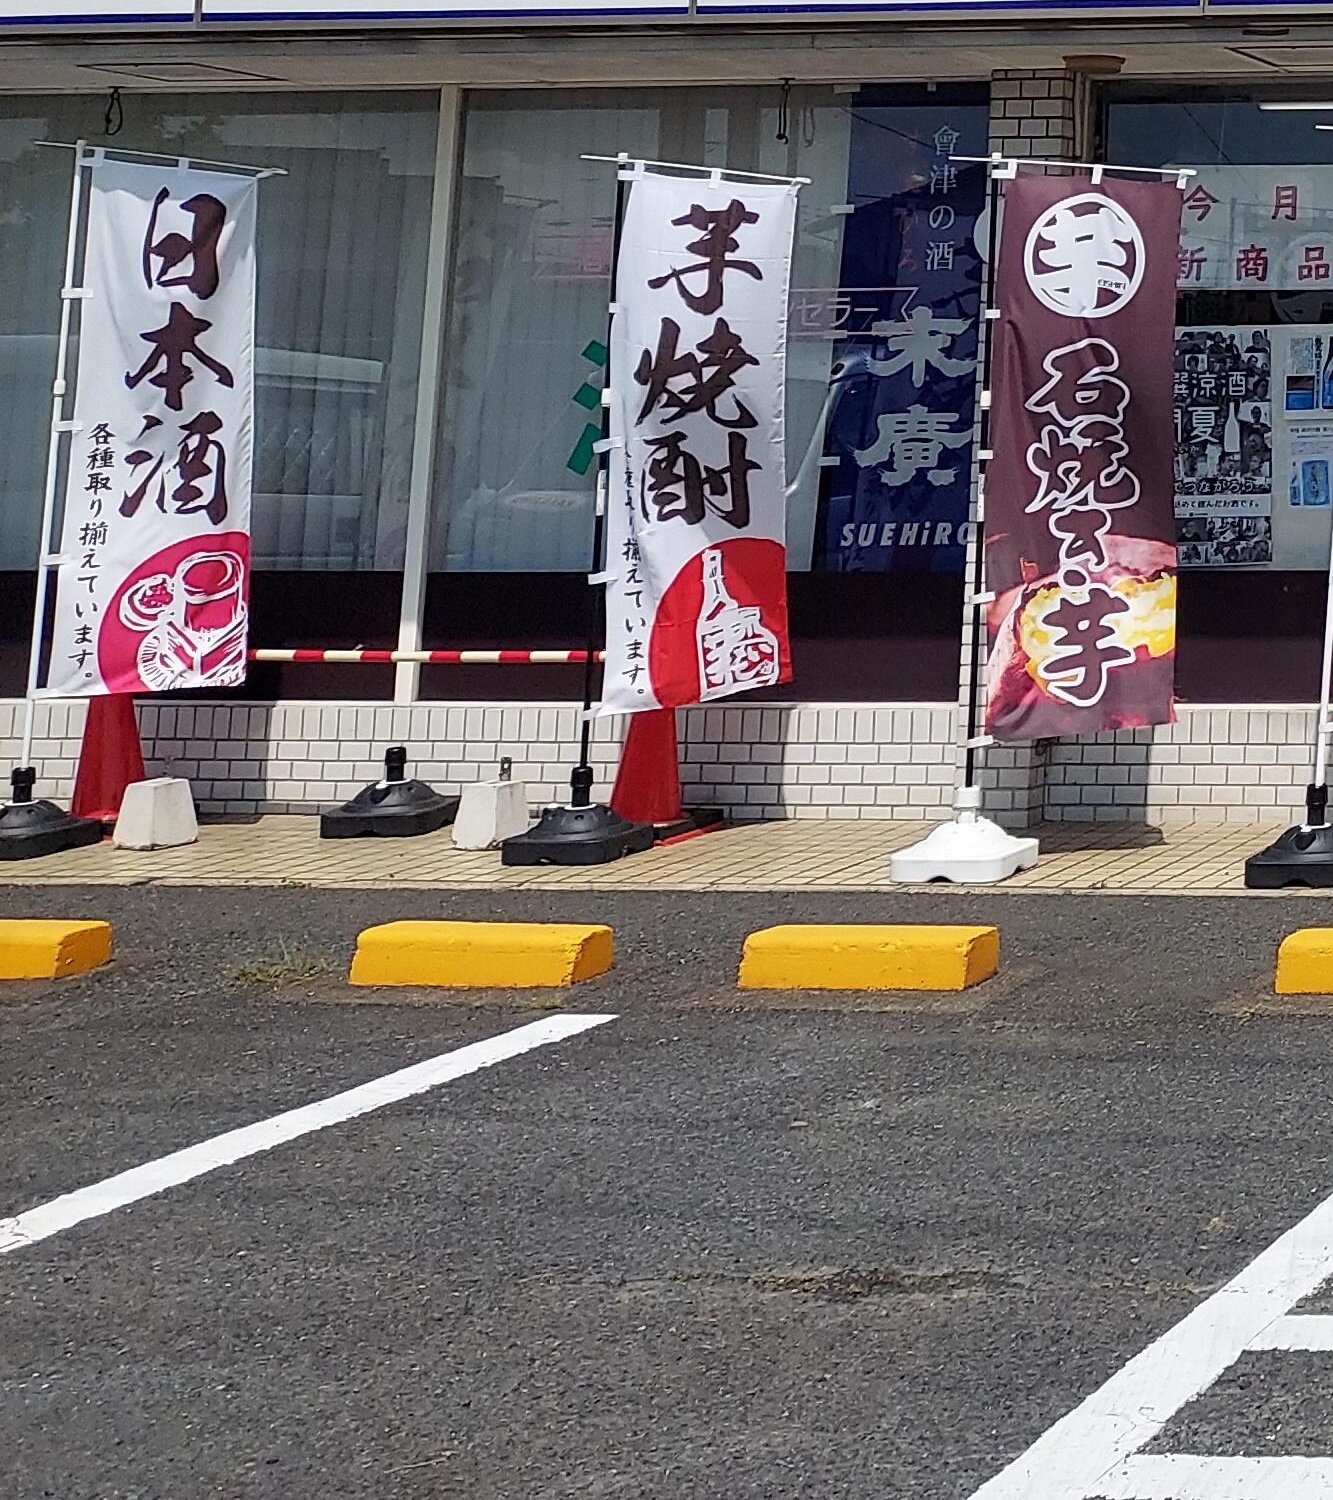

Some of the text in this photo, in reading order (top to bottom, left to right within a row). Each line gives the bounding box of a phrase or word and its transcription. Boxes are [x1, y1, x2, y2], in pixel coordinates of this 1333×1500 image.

[119, 184, 235, 526] 日本酒
[632, 198, 764, 530] 芋焼酎
[1025, 338, 1141, 708] 石焼き芋
[67, 420, 117, 681] 各種取り揃えています。
